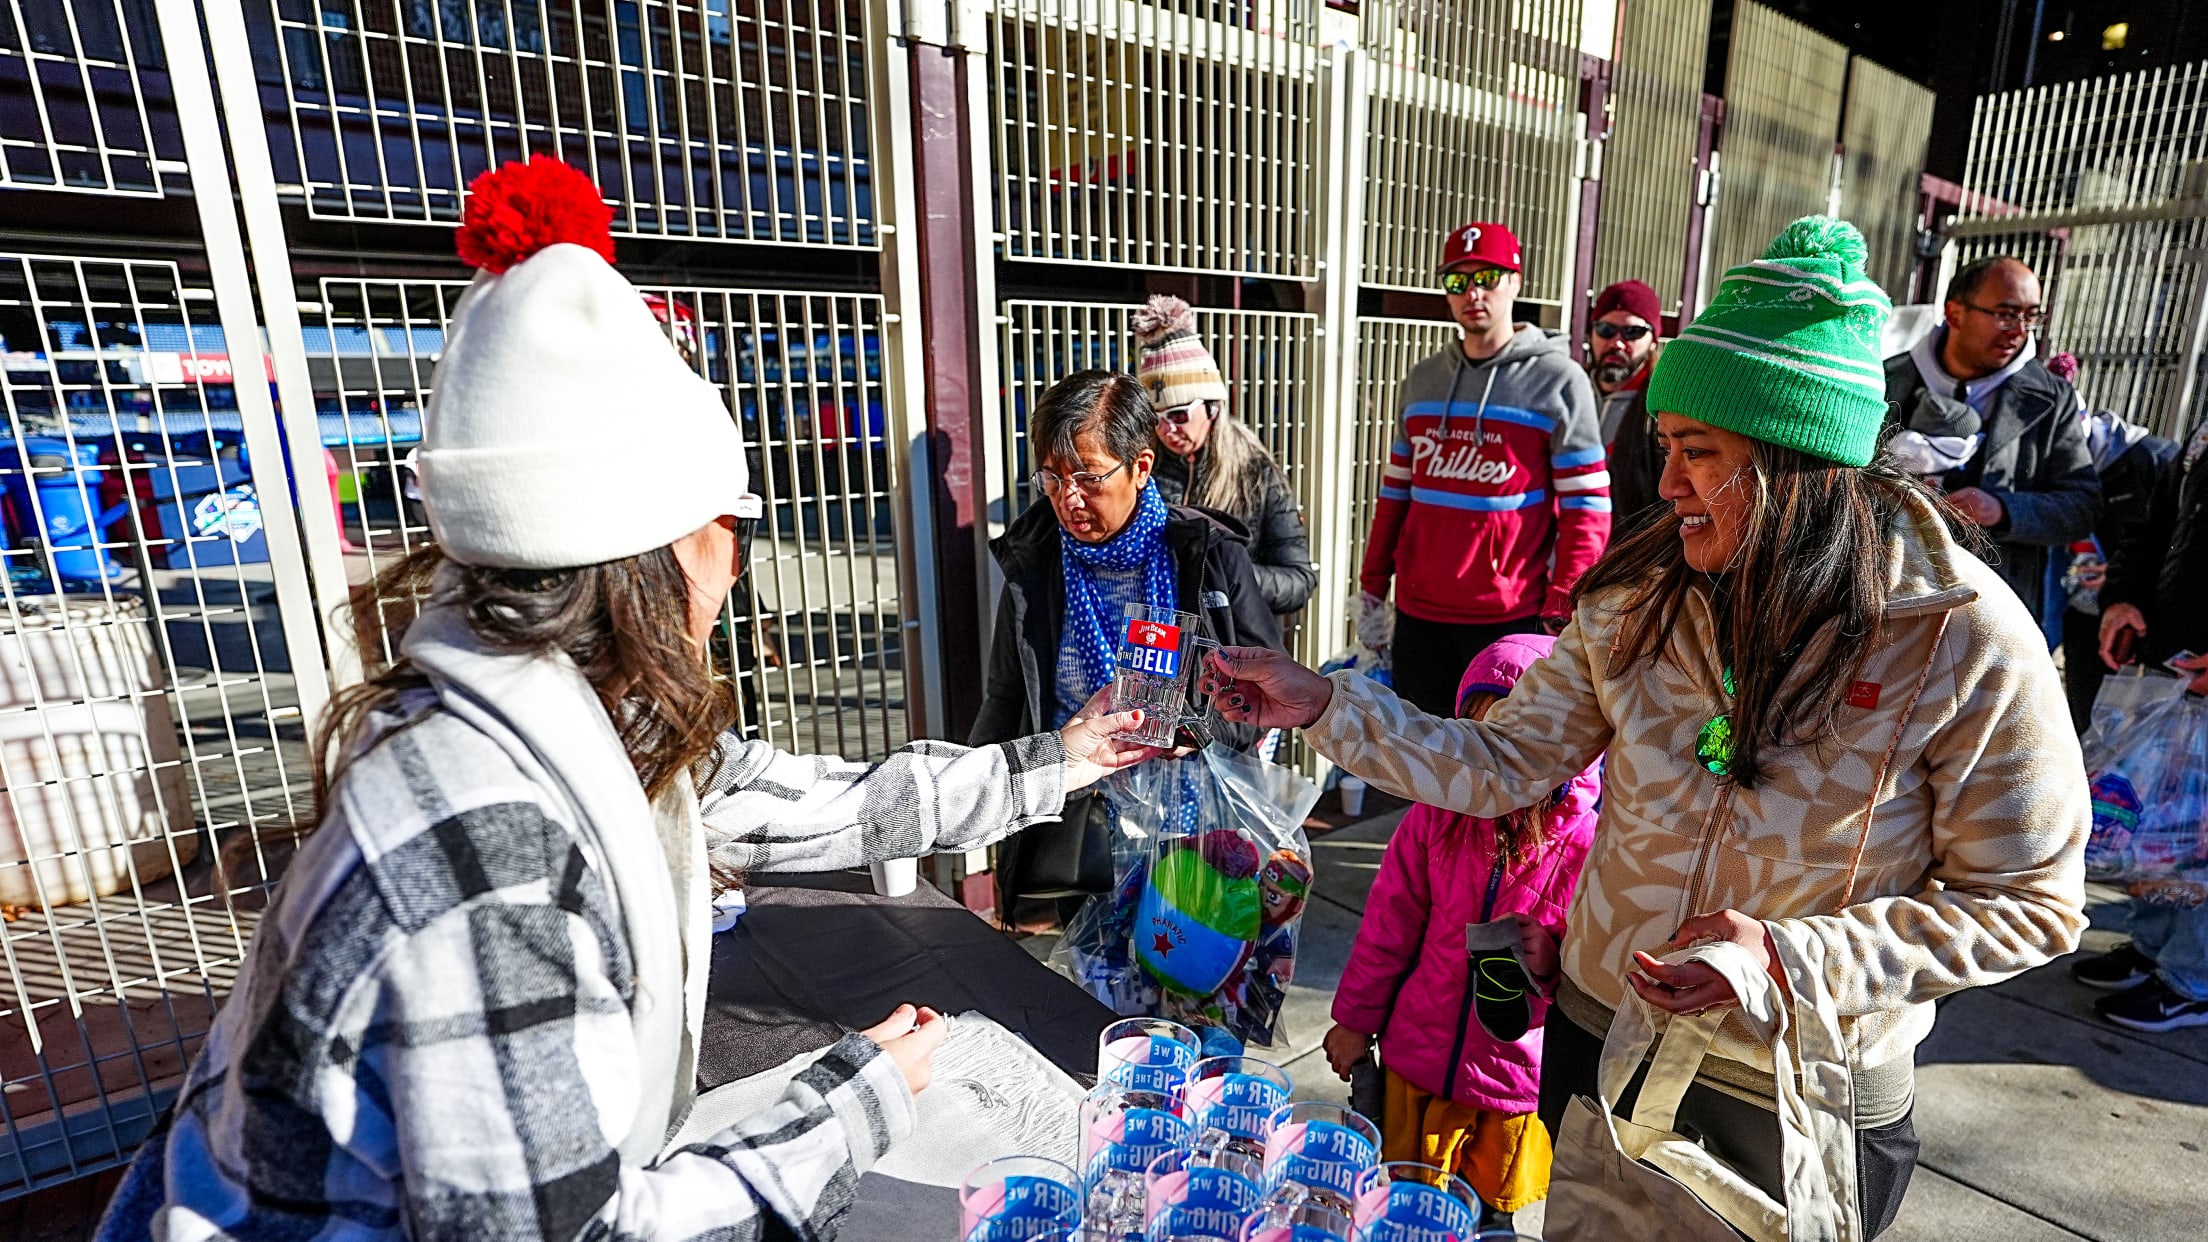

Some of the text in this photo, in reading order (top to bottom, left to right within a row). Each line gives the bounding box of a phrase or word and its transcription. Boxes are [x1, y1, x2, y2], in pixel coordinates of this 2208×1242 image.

[1461, 227, 1481, 252] P
[1426, 428, 1502, 443] PHLADELHIA
[1410, 436, 1517, 484] Phillies
[1122, 652, 1133, 661] THE
[1132, 646, 1174, 675] BELL
[1152, 916, 1186, 945] PHANATIC
